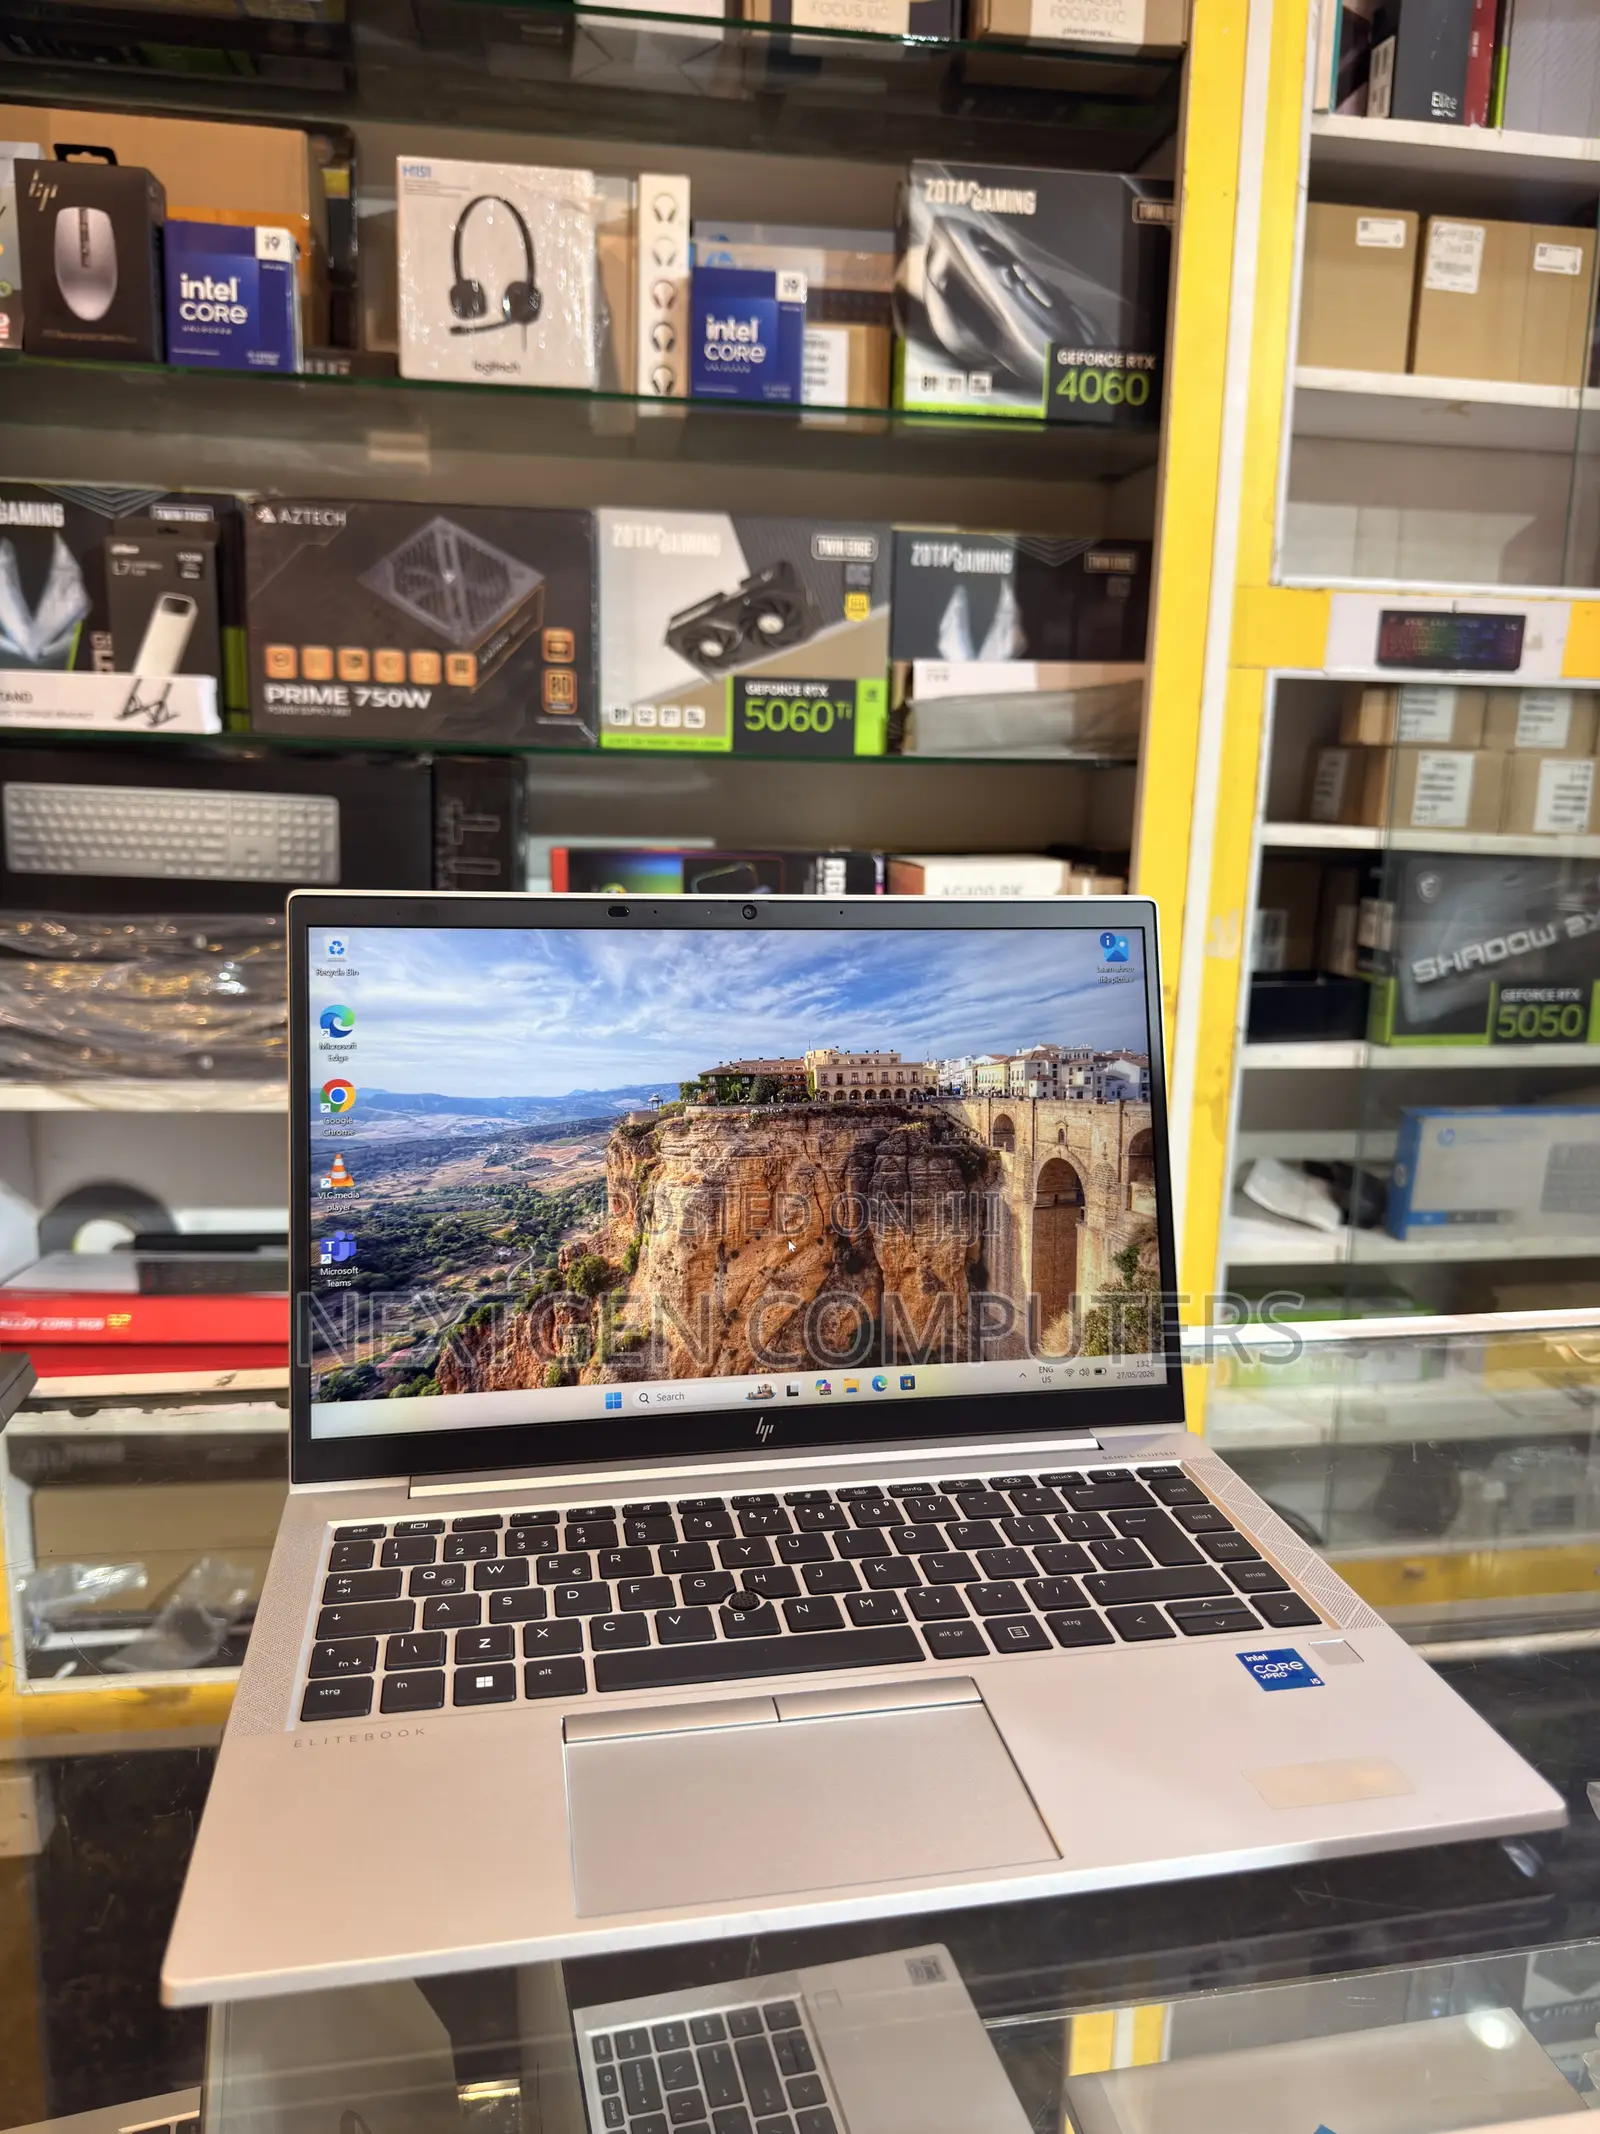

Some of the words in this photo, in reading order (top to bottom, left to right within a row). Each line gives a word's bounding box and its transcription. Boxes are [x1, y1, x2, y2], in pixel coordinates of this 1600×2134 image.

[971, 189, 1037, 215] GAMING
[179, 273, 239, 302] intel
[705, 313, 759, 342] intel
[1056, 347, 1125, 368] GEFORCE
[1126, 352, 1156, 370] RTX
[1056, 368, 1150, 406] 4060
[0, 501, 65, 528] GAMING
[277, 507, 347, 527] AZTECH
[953, 550, 1014, 574] GAMING
[744, 681, 802, 698] GEFORCE
[264, 684, 349, 706] PRIME
[354, 687, 432, 710] 750W
[744, 698, 835, 733] 5060
[1411, 923, 1559, 983] SHADOW
[1497, 1003, 1584, 1038] 5050
[319, 1041, 358, 1052] Microsoft
[328, 1053, 350, 1064] Edge
[323, 1115, 354, 1127] Google
[322, 1127, 356, 1138] Chrome
[318, 1191, 337, 1201] VLC
[337, 1191, 360, 1201] media
[327, 1203, 352, 1214] player
[320, 1265, 359, 1277] Microsoft
[327, 1279, 352, 1289] Teams
[1038, 1365, 1054, 1375] ENG
[1116, 1370, 1155, 1380] 27/05/2026
[1041, 1376, 1053, 1384] US
[656, 1390, 686, 1403] Search
[755, 1416, 775, 1443] hp
[903, 1530, 916, 1539] O
[958, 1527, 968, 1535] P
[788, 1539, 800, 1548] U
[455, 1547, 465, 1555] 2
[669, 1549, 680, 1558] T
[740, 1546, 752, 1556] Y
[610, 1554, 622, 1563] R
[487, 1564, 505, 1574] W
[548, 1560, 559, 1569] E
[874, 1563, 887, 1573] K
[932, 1559, 944, 1569] L
[422, 1571, 437, 1580] Q
[754, 1574, 767, 1583] H
[441, 1577, 456, 1586] @
[694, 1579, 707, 1588] G
[630, 1584, 641, 1594] F
[567, 1590, 579, 1599] D
[502, 1596, 513, 1606] S
[859, 1599, 874, 1608] M
[436, 1602, 450, 1612] A
[796, 1604, 809, 1613] N
[668, 1615, 681, 1625] V
[733, 1612, 746, 1622] B
[603, 1622, 616, 1631] C
[1062, 1619, 1081, 1627] strg
[536, 1628, 549, 1638] X
[938, 1629, 951, 1637] alt
[479, 1638, 491, 1649] Z
[1244, 1653, 1268, 1662] intel
[538, 1667, 552, 1676] alt
[396, 1681, 408, 1689] fn
[1310, 1677, 1322, 1686] i5
[319, 1687, 341, 1697] strg
[292, 1726, 427, 1749] ELITEBOOK
